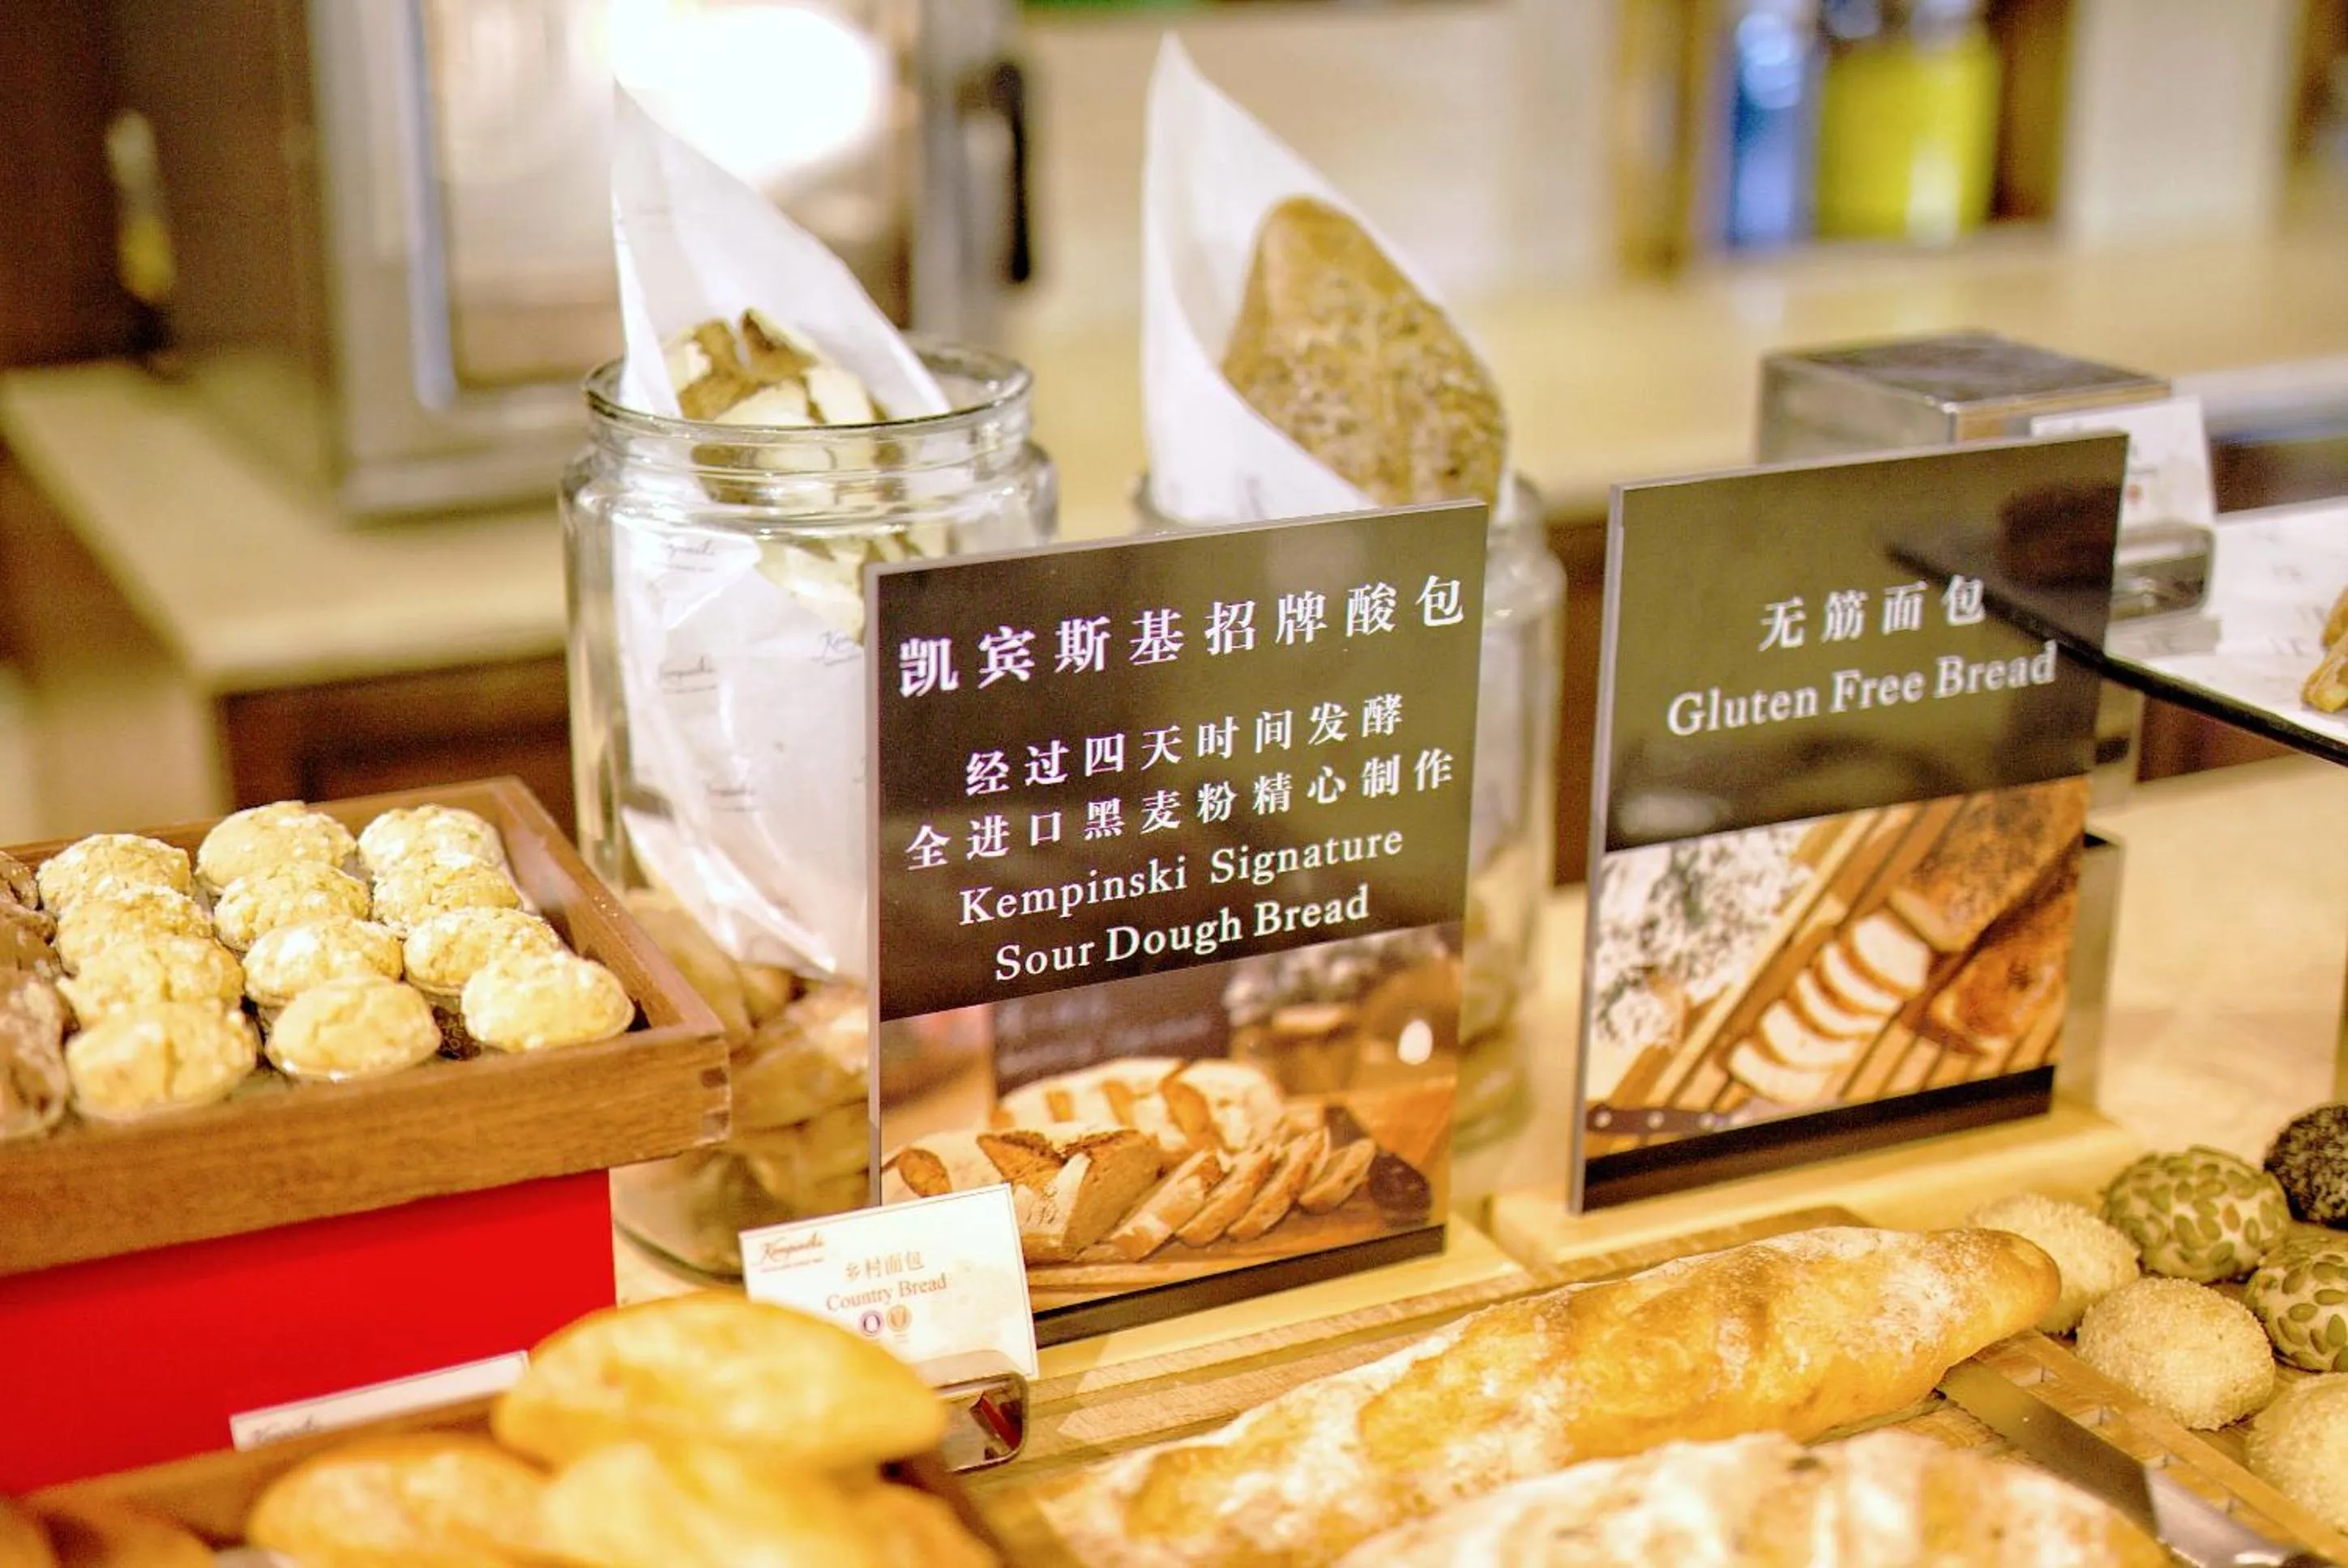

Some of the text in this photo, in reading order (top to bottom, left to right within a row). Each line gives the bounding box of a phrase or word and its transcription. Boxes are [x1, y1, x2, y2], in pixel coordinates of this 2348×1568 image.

[898, 575, 1465, 698] 凯宾斯基招牌酸包
[1759, 575, 1986, 652] 无筋面包
[1666, 639, 2058, 737] Gluten Free Bread
[965, 694, 1403, 797] 经过四天时间发酵
[905, 748, 1454, 871] 全进口黑麦粉精心制作
[960, 831, 1403, 925] Kempinski Signature
[995, 885, 1370, 981] Sour Dough Bread
[826, 1273, 947, 1311] Country Bread
